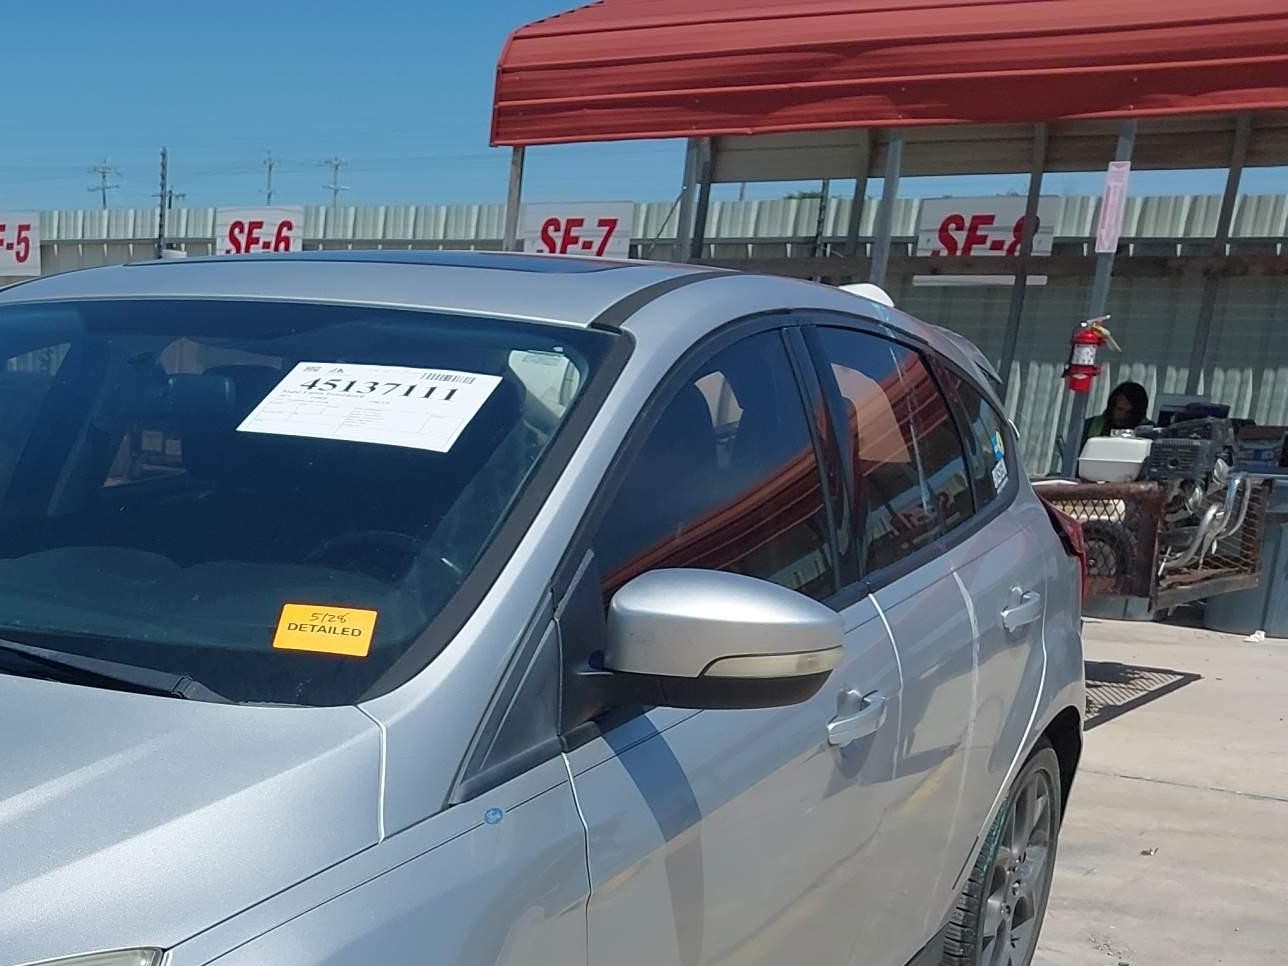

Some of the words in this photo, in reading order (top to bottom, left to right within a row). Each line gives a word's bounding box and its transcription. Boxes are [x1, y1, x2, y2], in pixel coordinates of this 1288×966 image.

[224, 220, 294, 255] SF-6
[537, 218, 619, 258] SF-7
[300, 377, 458, 401] 45137111
[287, 623, 362, 637] DETAILED
